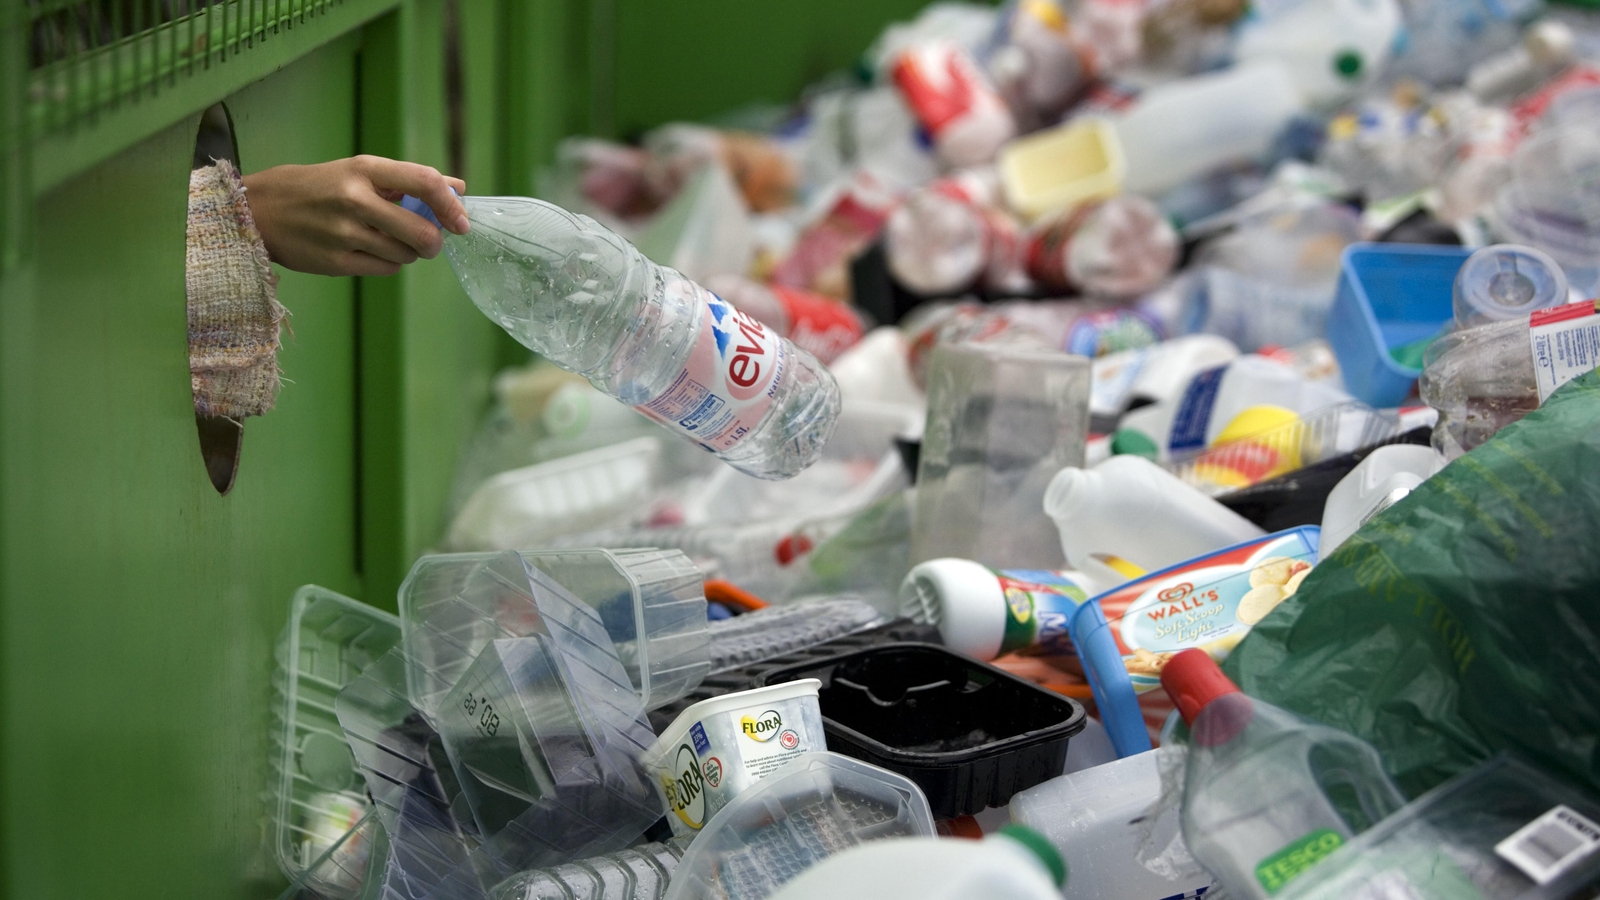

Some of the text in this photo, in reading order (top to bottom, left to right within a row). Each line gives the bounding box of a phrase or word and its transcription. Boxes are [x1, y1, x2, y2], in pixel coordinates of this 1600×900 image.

[767, 360, 784, 398] Natural
[730, 427, 750, 441] 1.5L
[1148, 590, 1218, 622] WALL'S
[1154, 603, 1225, 640] Soft Scoop
[1177, 621, 1214, 644] Light
[742, 716, 783, 734] FLORA
[1258, 832, 1341, 890] TESCO
